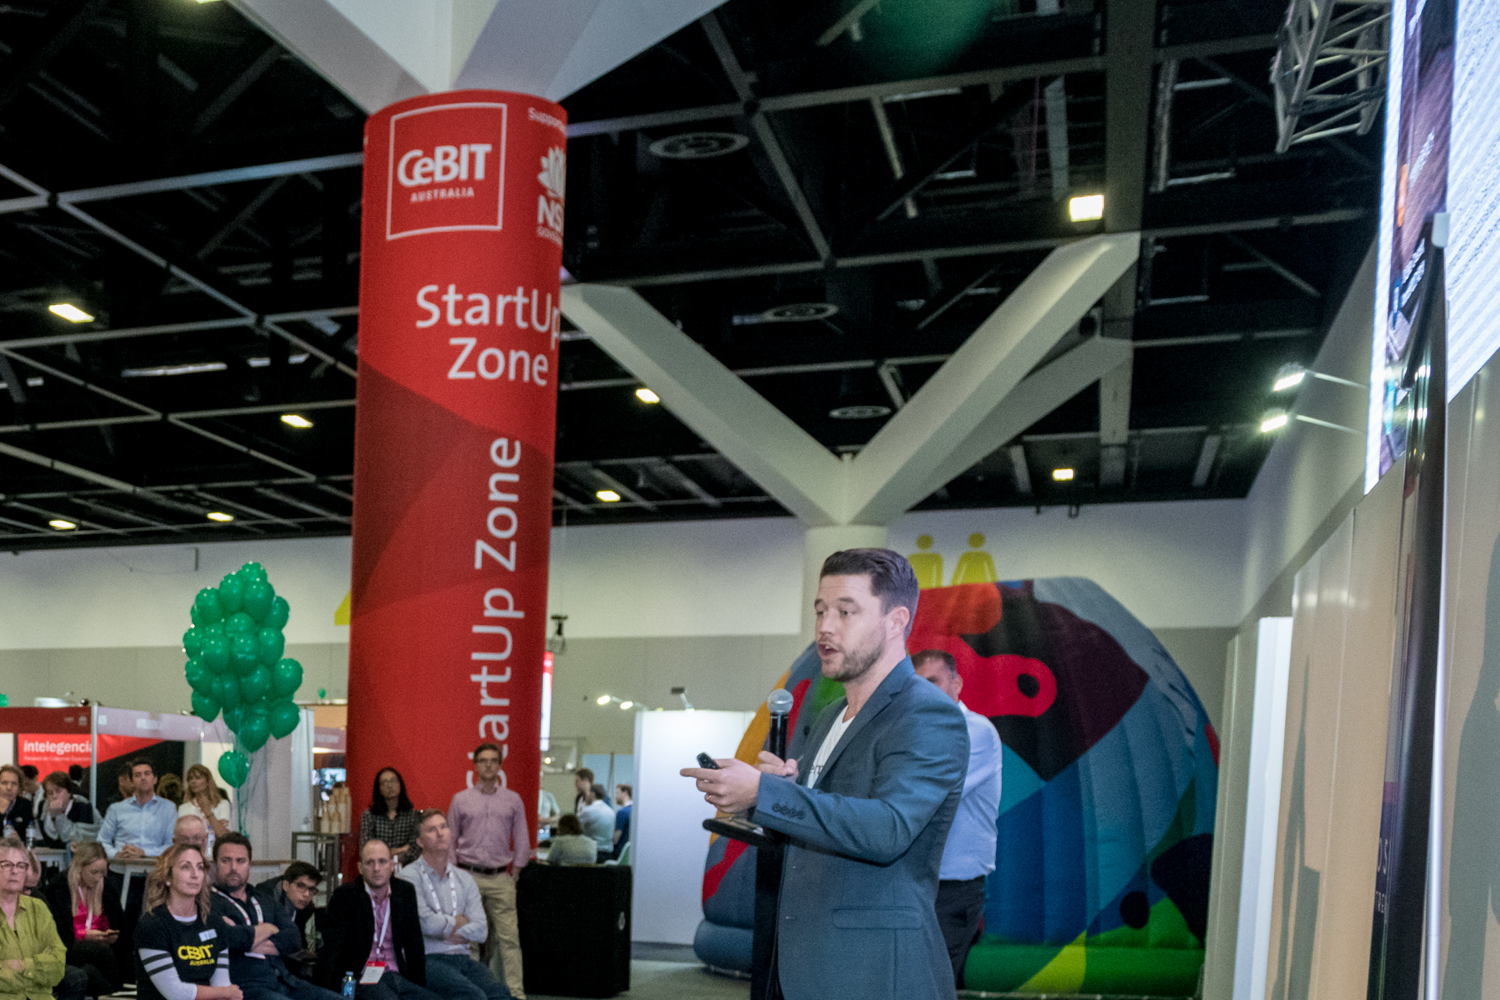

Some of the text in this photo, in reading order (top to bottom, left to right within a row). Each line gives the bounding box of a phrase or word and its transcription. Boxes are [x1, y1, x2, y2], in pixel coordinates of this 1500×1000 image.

[397, 144, 492, 187] CeBIT
[410, 187, 474, 203] AUSTRALIA
[537, 194, 563, 235] NS
[416, 283, 560, 350] StartUp
[448, 337, 549, 387] Zone
[466, 437, 525, 789] artUp Zone
